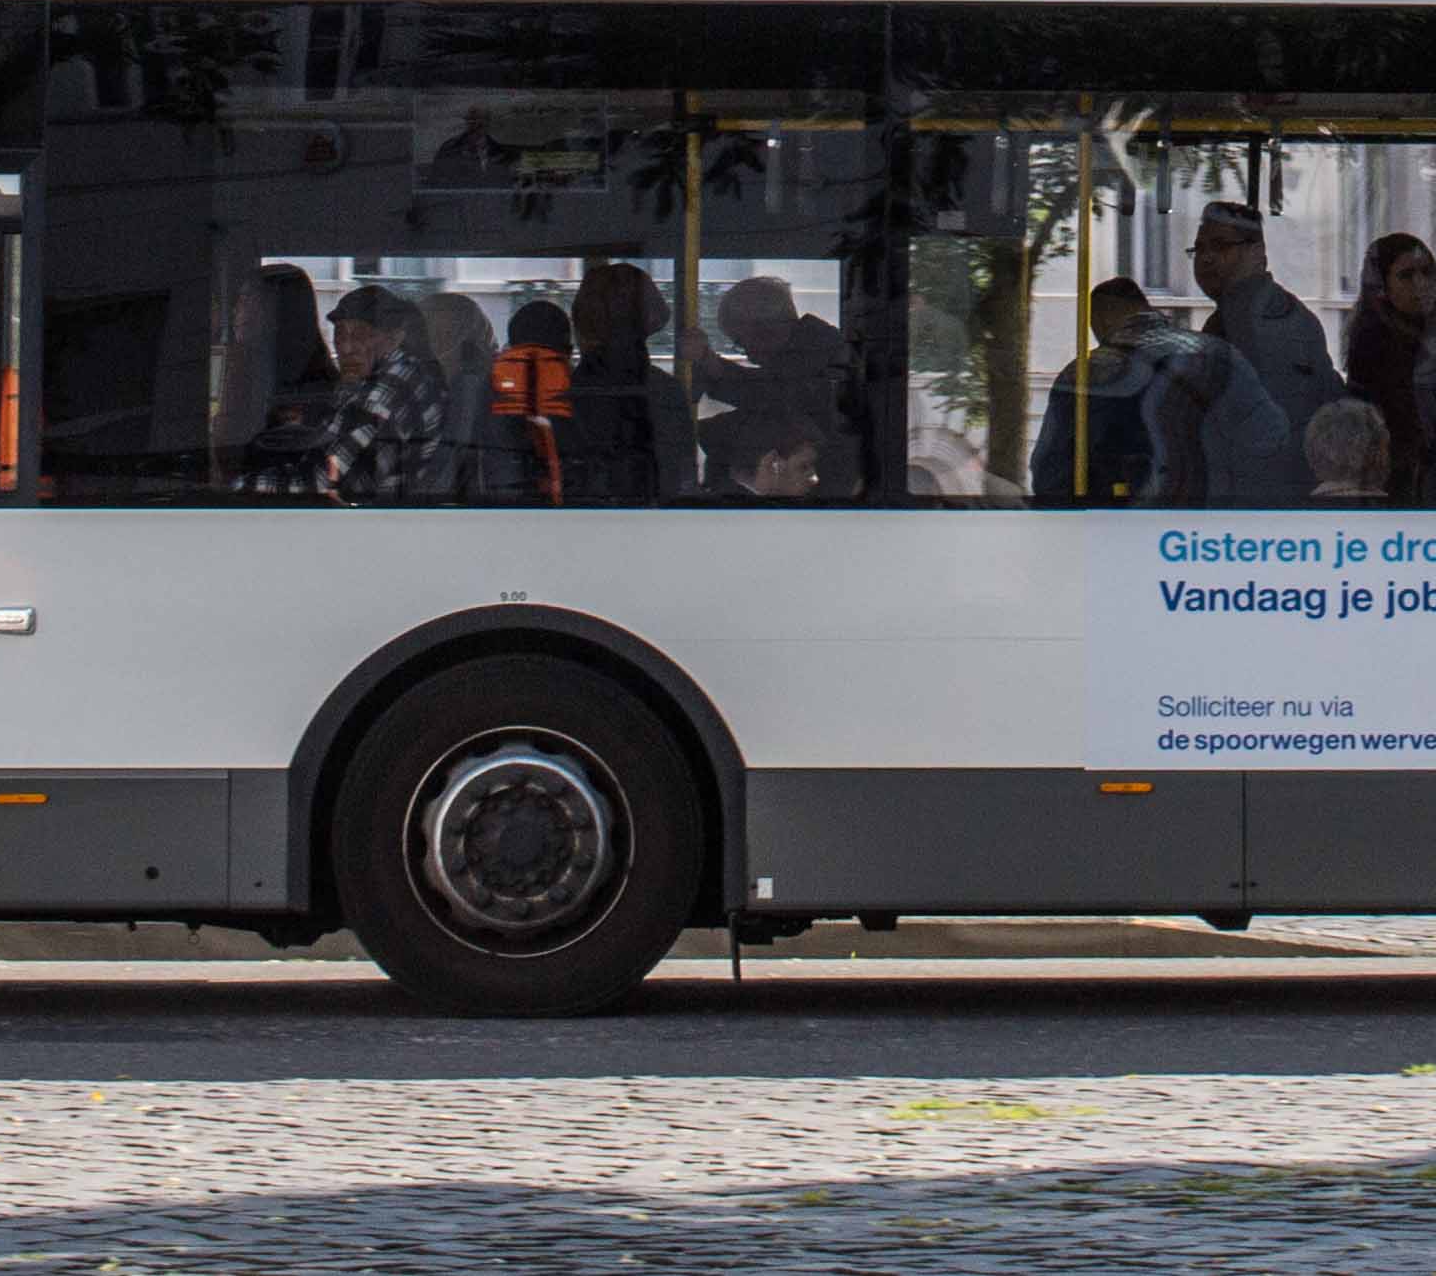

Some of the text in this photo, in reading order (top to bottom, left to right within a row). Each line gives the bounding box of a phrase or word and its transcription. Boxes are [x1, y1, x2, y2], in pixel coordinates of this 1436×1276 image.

[1158, 530, 1322, 563] Gisteren
[1332, 531, 1368, 569] je
[1158, 580, 1327, 619] Vandaag
[1337, 581, 1374, 619] je
[1157, 695, 1354, 717] Solliciteer nu via
